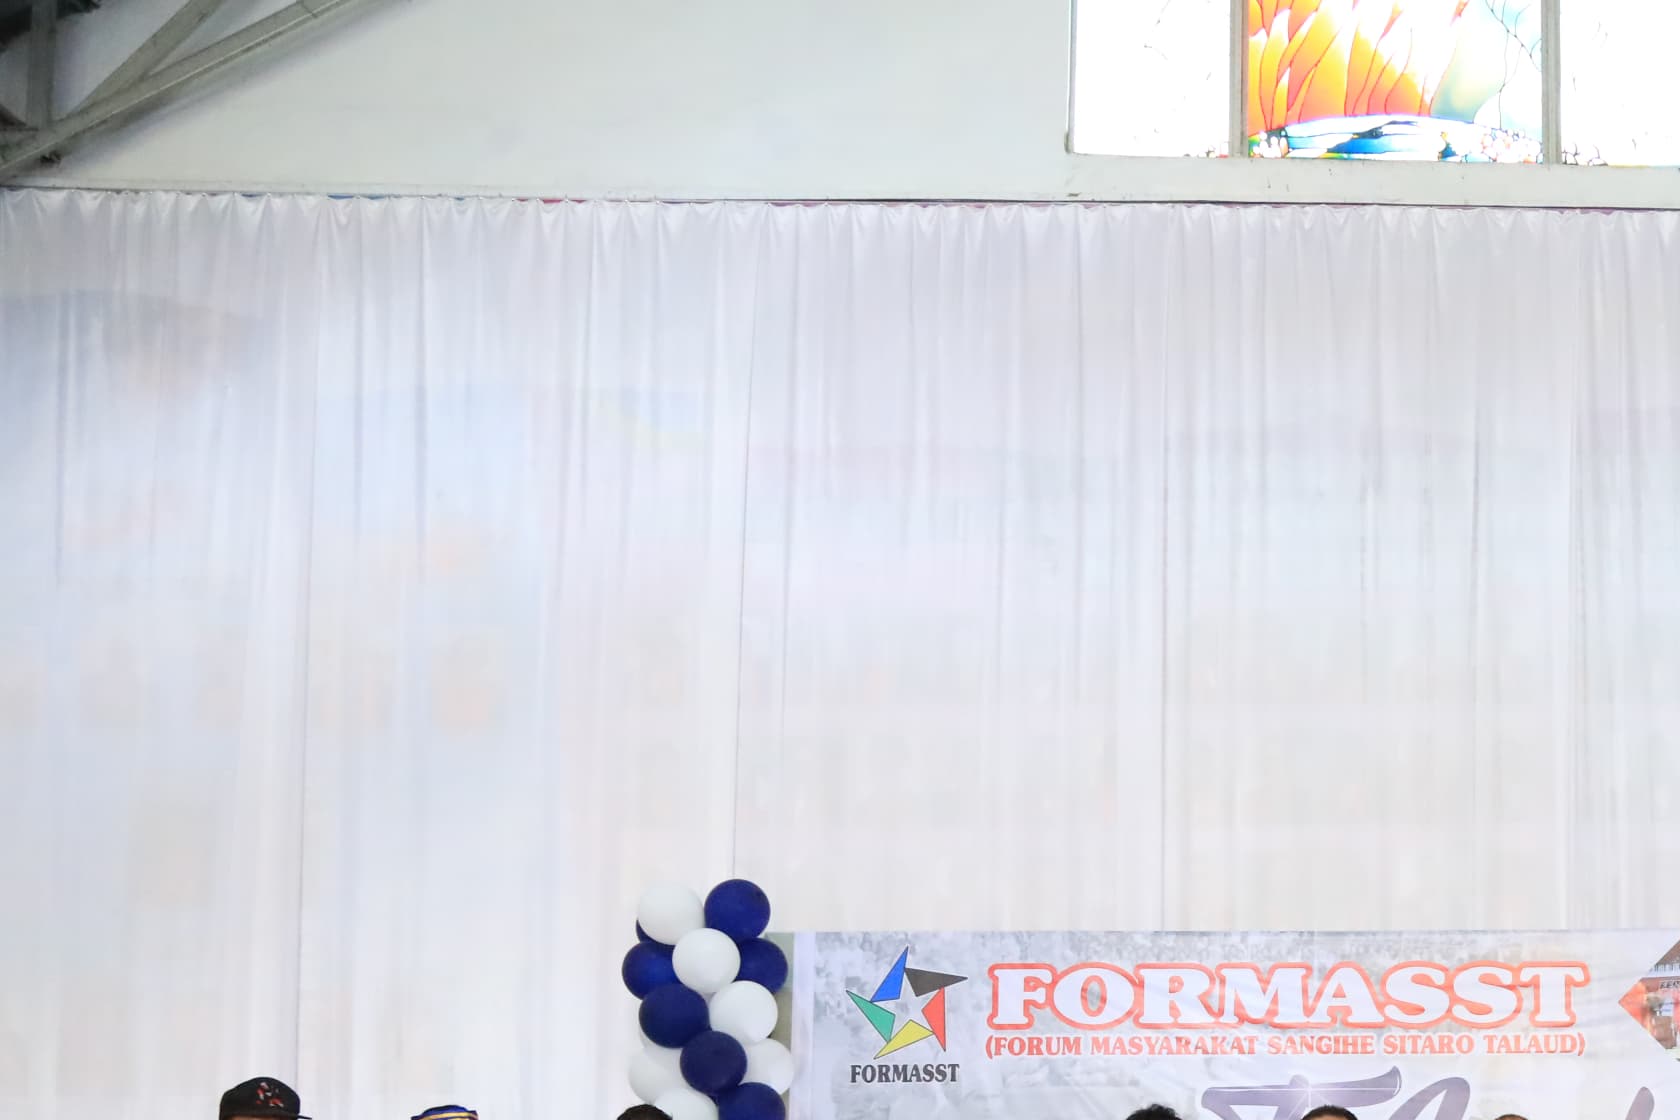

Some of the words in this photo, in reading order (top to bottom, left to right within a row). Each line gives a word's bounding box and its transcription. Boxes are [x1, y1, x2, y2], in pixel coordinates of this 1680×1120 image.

[986, 959, 1592, 1032] FORMASST
[985, 1035, 1081, 1058] (FORUM
[1091, 1036, 1257, 1056] MASYARAKAT
[1269, 1035, 1374, 1055] SANGIHE
[1384, 1035, 1474, 1055] SITARO
[1486, 1034, 1585, 1056] TALAUD)
[850, 1064, 960, 1083] FORMASST
